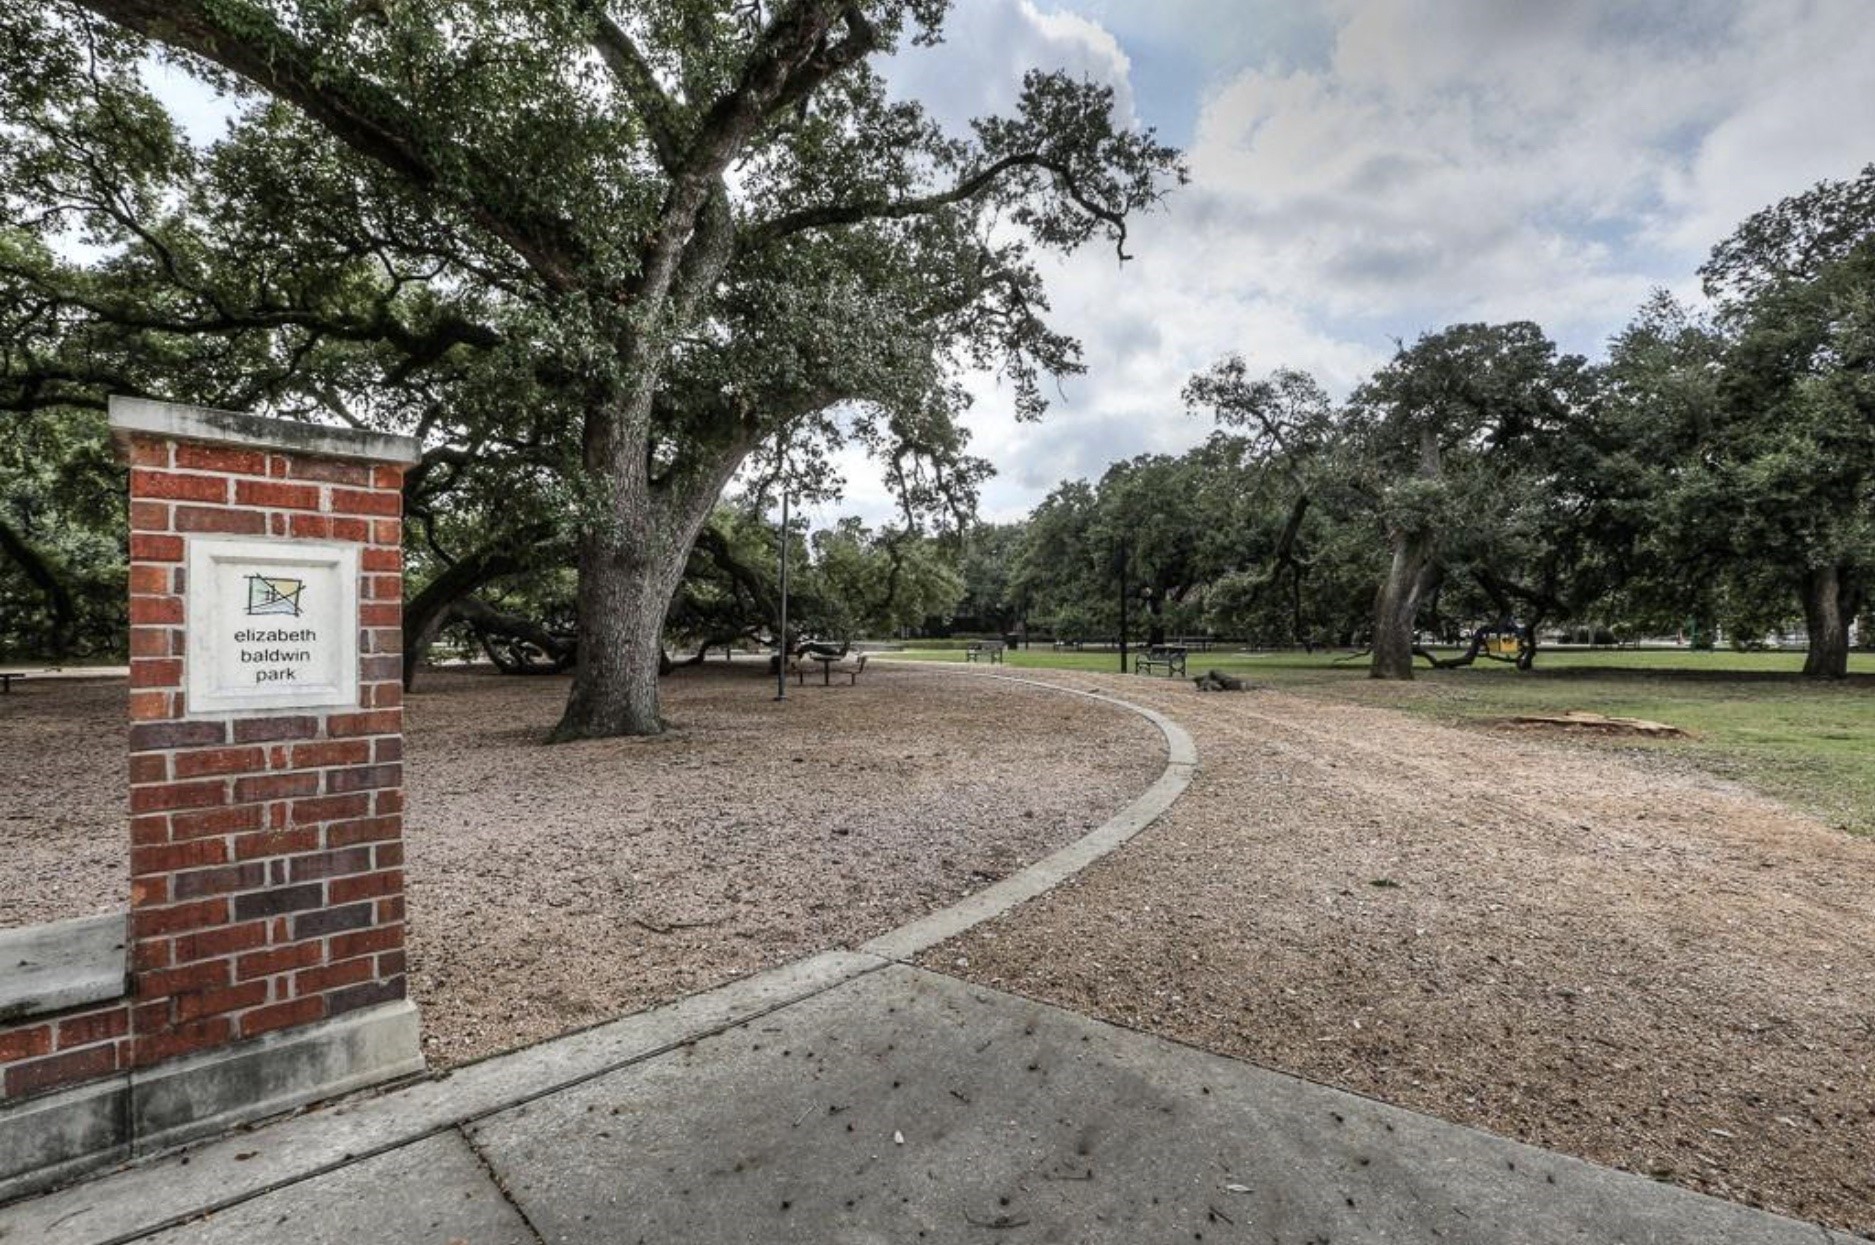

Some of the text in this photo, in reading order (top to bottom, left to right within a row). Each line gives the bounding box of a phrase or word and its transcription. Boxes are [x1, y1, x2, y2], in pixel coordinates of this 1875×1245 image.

[234, 629, 316, 642] elizabeth
[241, 649, 311, 663] baldwin
[256, 667, 297, 683] park
